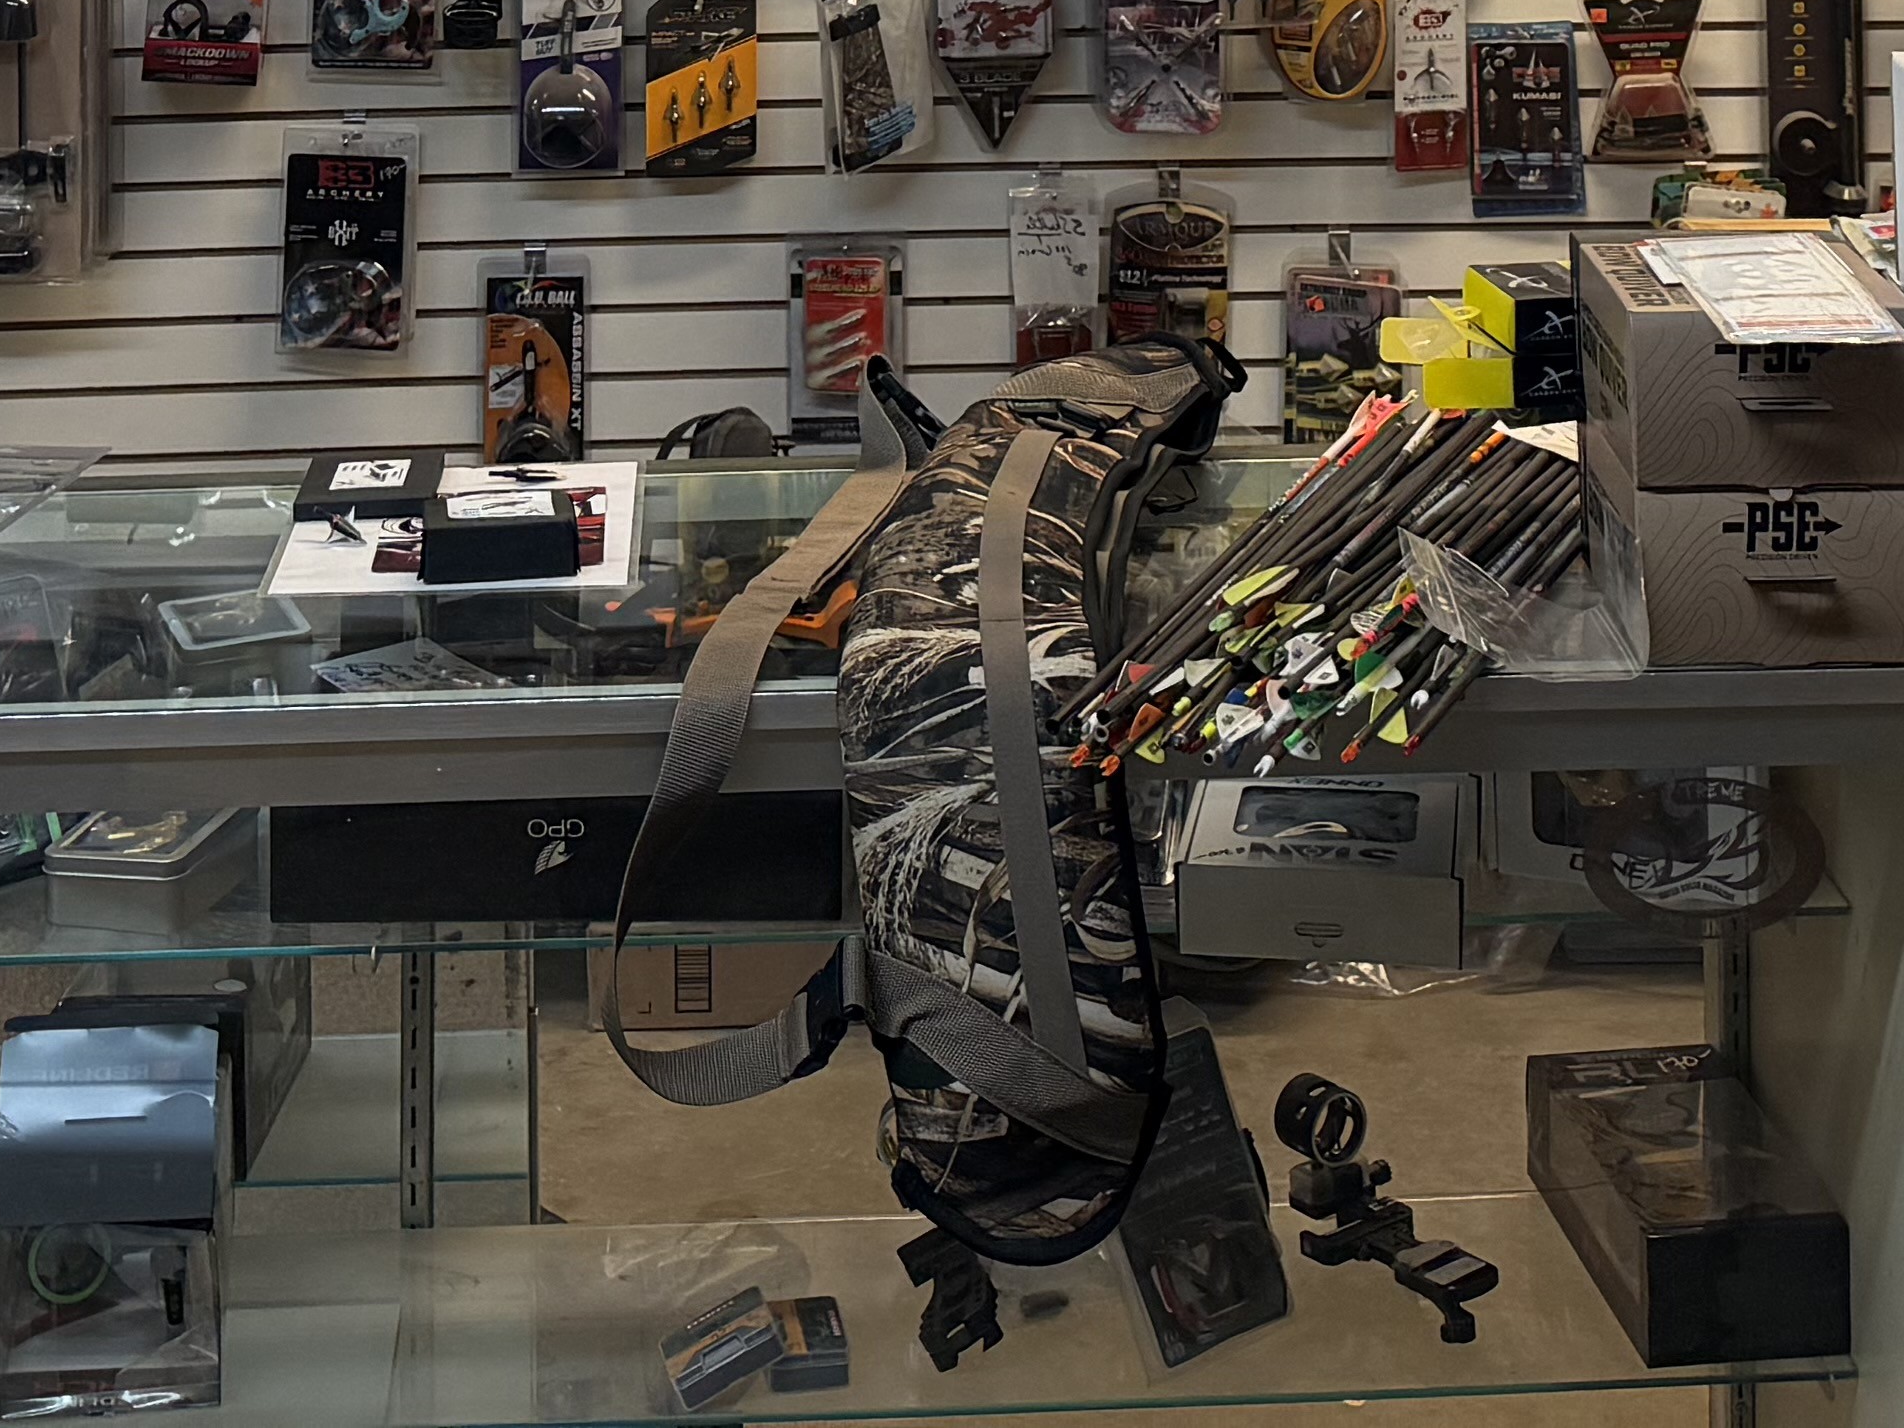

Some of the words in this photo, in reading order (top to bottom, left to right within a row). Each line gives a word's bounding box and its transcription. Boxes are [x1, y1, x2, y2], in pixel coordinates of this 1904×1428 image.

[156, 46, 251, 61] SMACKDOWN
[1746, 501, 1819, 552] PSE
[527, 819, 584, 837] GPO
